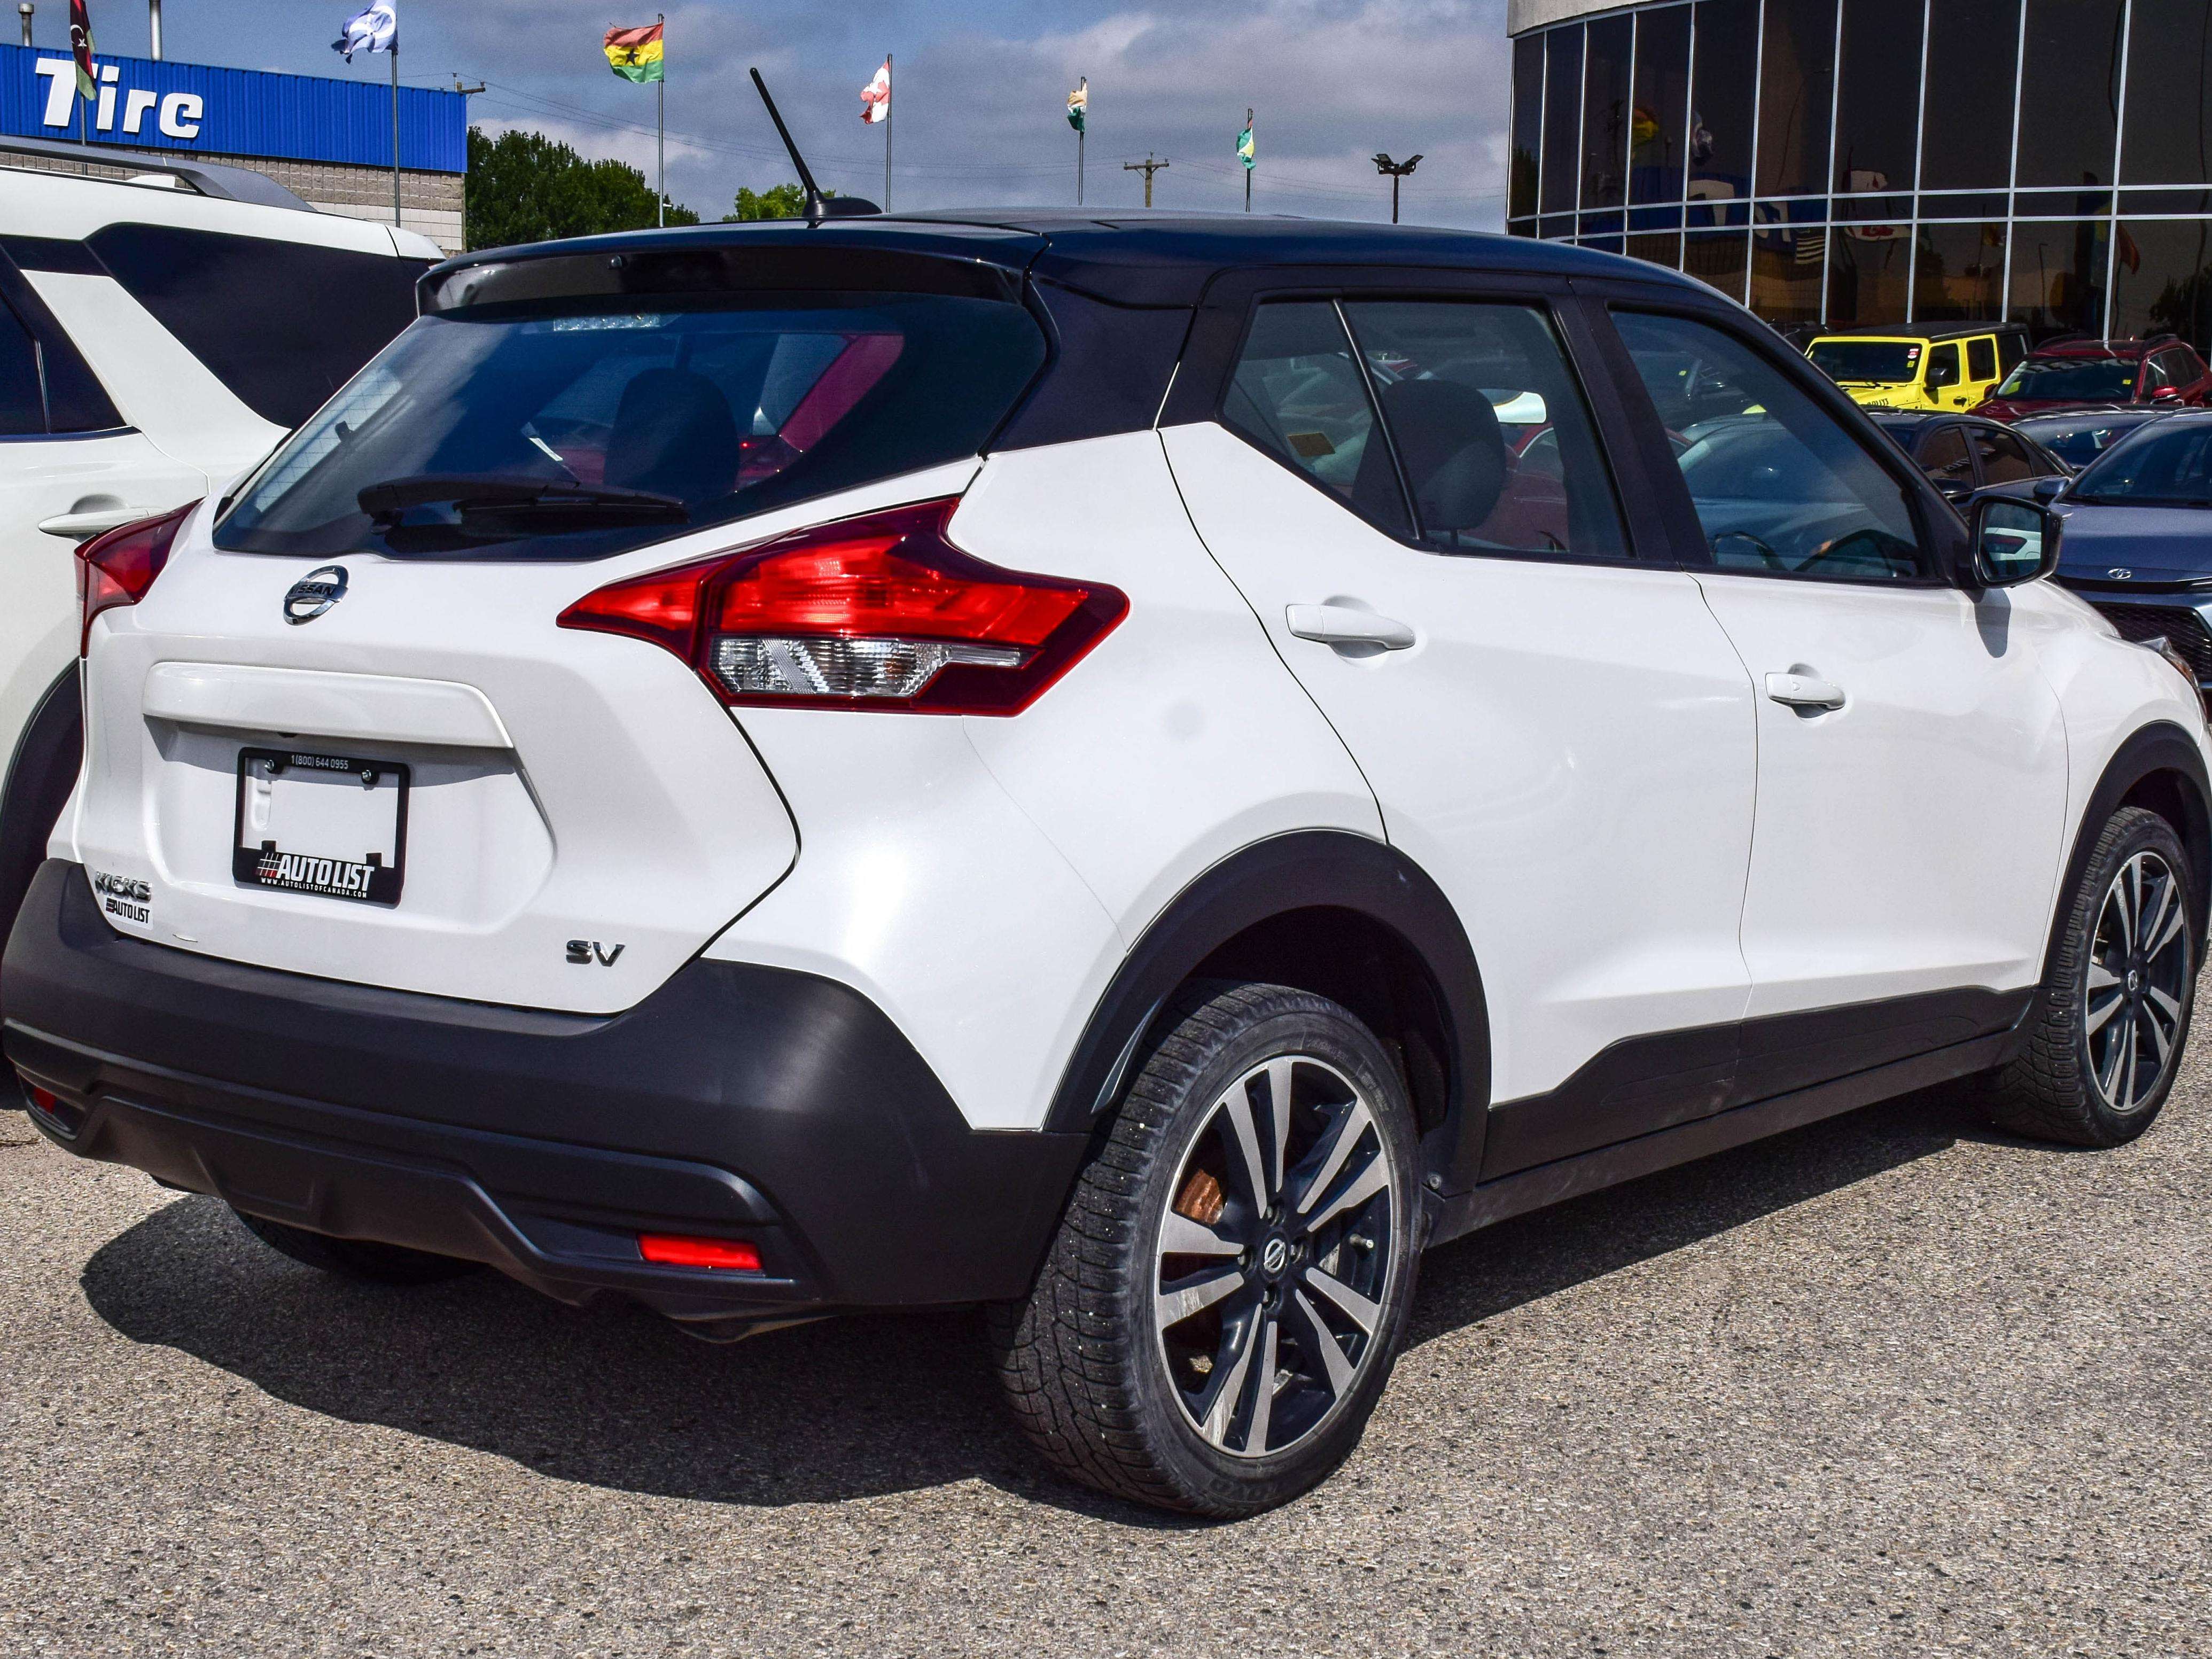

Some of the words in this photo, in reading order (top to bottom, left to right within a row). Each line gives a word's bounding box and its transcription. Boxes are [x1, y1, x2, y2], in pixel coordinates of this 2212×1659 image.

[35, 57, 203, 138] Tire
[316, 757, 329, 767] 644
[331, 759, 348, 769] 0955
[95, 871, 152, 902] KICKS
[566, 940, 626, 967] SV
